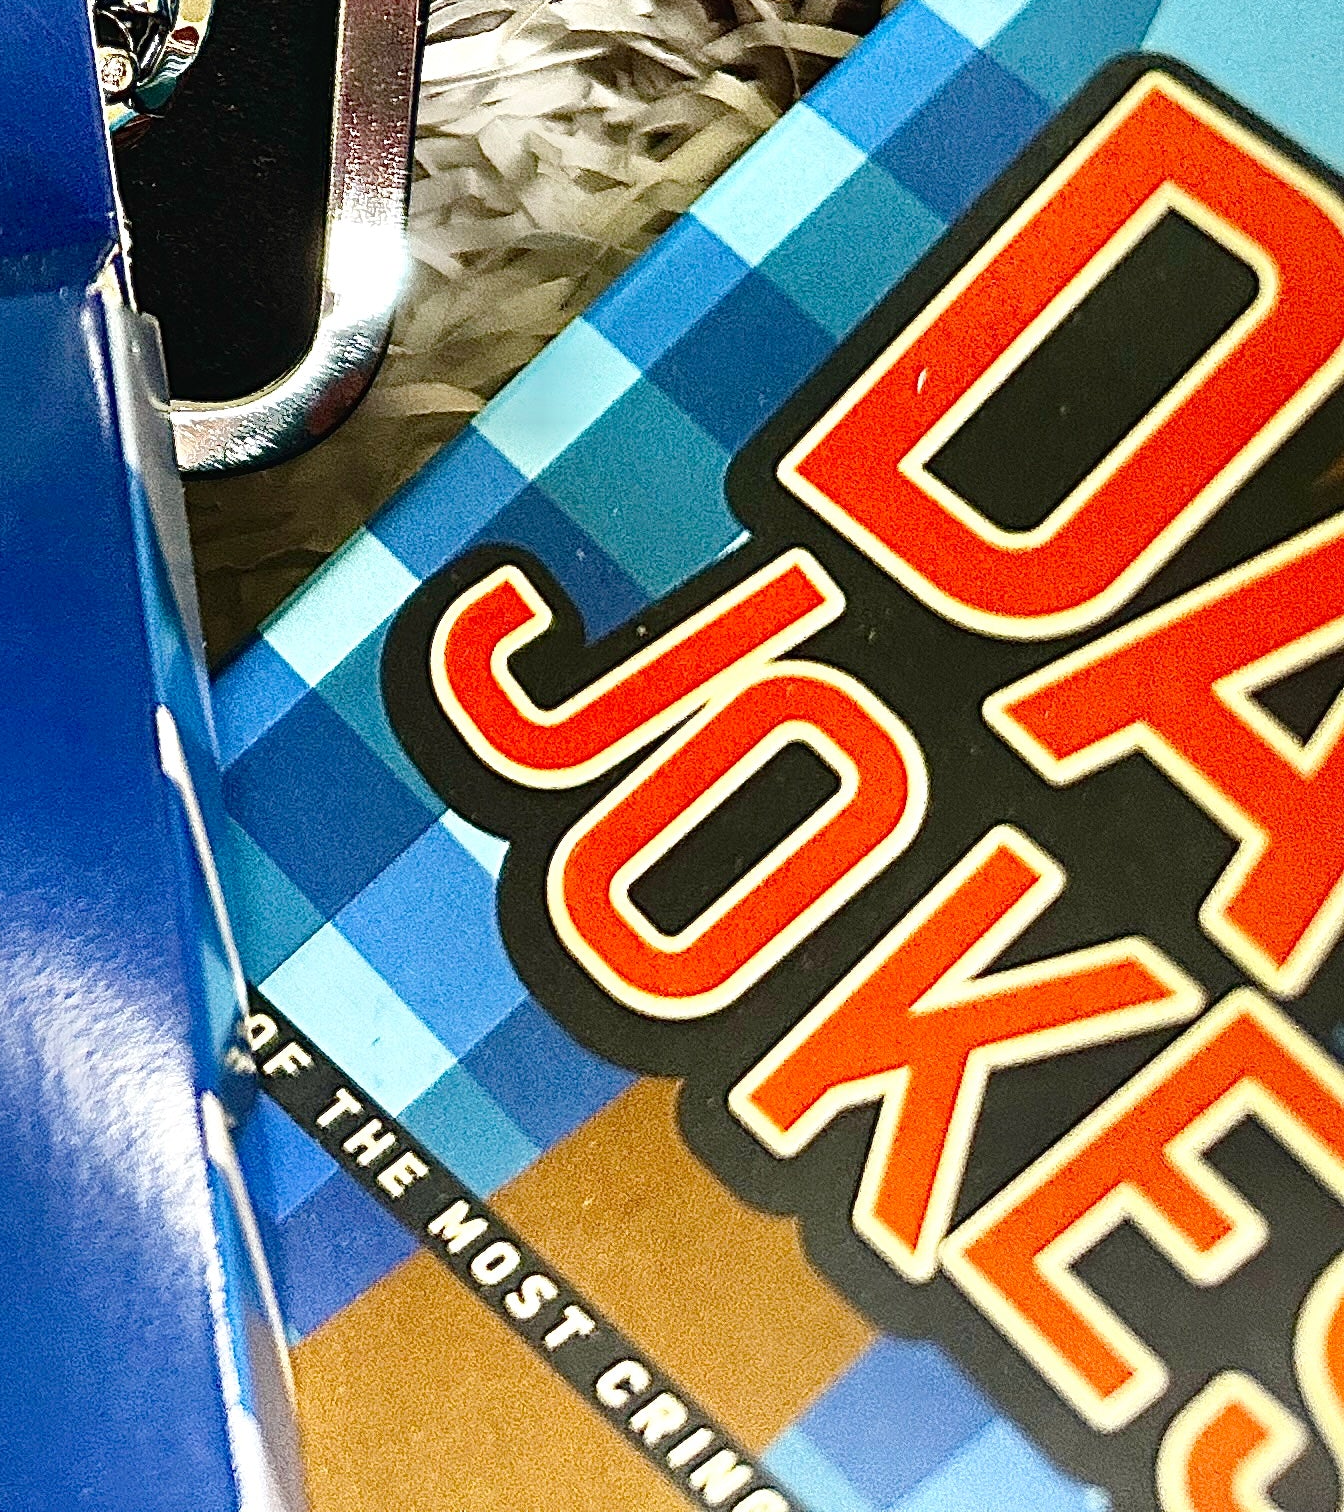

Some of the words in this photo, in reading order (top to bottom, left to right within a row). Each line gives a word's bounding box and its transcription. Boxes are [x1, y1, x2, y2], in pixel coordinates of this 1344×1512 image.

[316, 1087, 431, 1199] THE
[427, 1199, 597, 1352] MOST
[429, 546, 1344, 1512] JOKE
